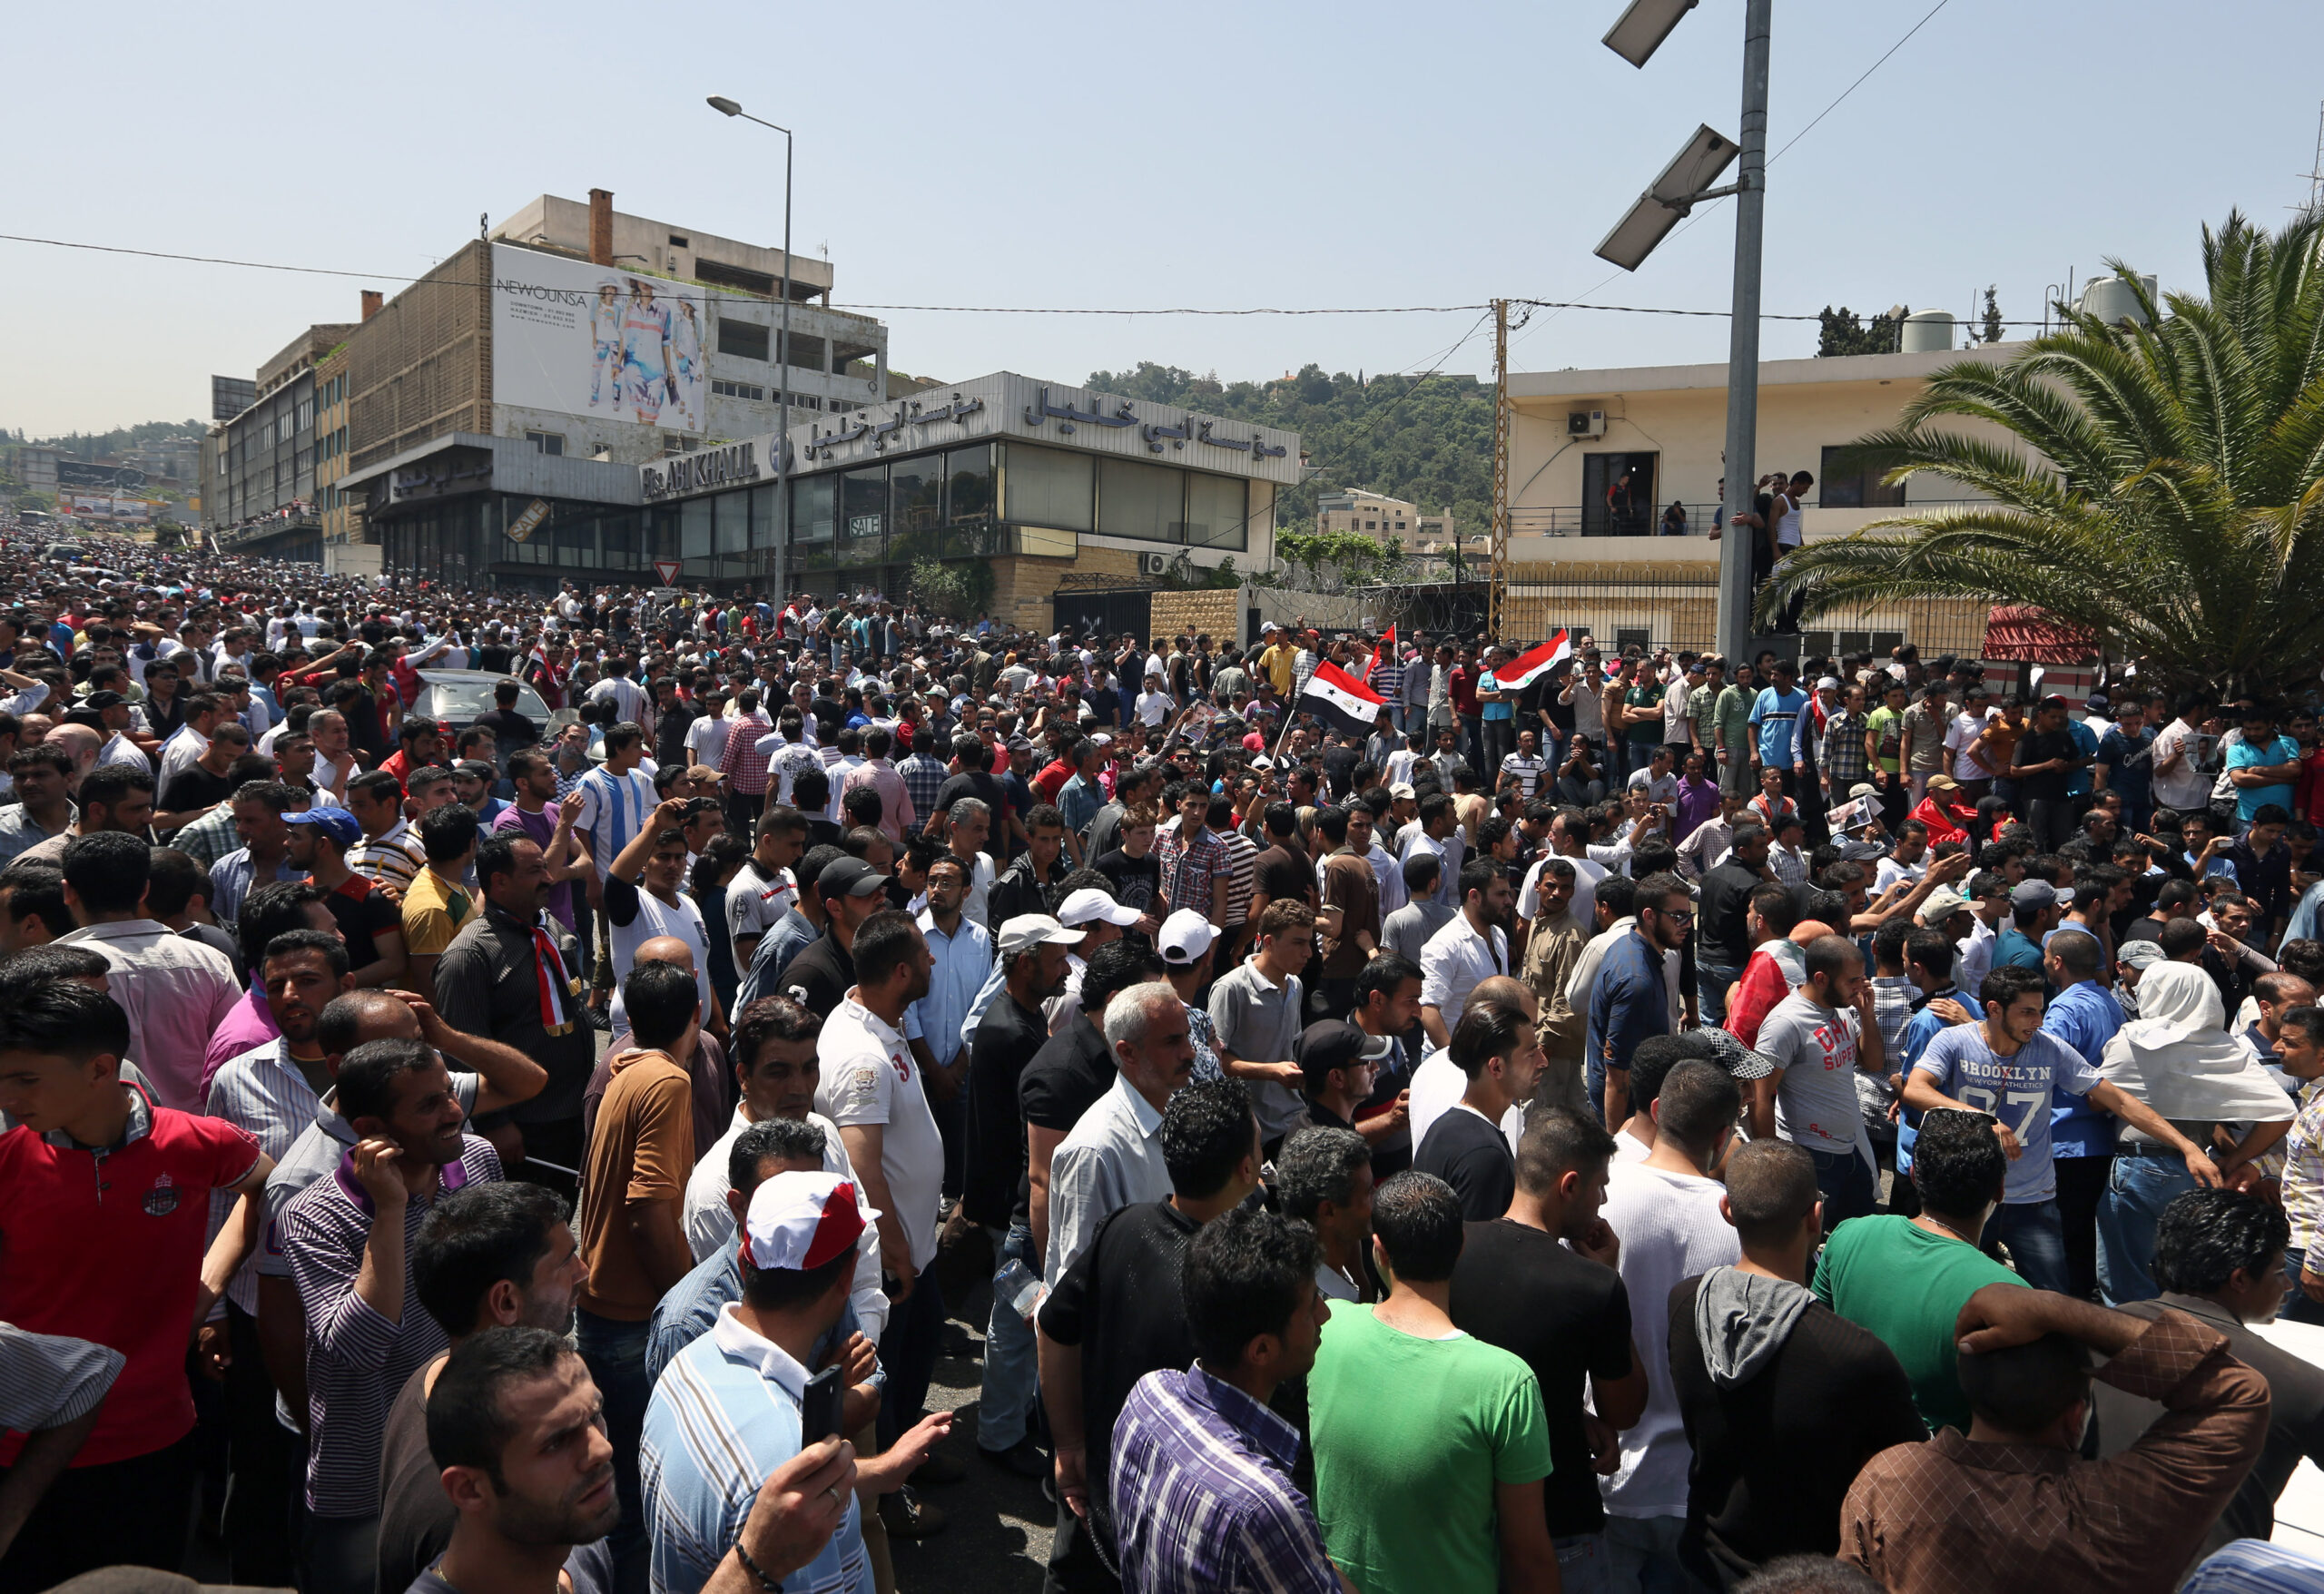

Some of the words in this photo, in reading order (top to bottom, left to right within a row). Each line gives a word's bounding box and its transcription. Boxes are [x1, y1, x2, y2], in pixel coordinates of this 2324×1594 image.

[497, 278, 587, 309] NEWOUNSA
[1025, 386, 1140, 435] خليل
[804, 411, 869, 460] خليل
[666, 458, 693, 493] ABI
[694, 443, 757, 487] KHALIL
[509, 499, 549, 543] SALE
[851, 517, 879, 537] SALE
[891, 1053, 910, 1083] 3
[1959, 1059, 2052, 1080] BROOKLYN
